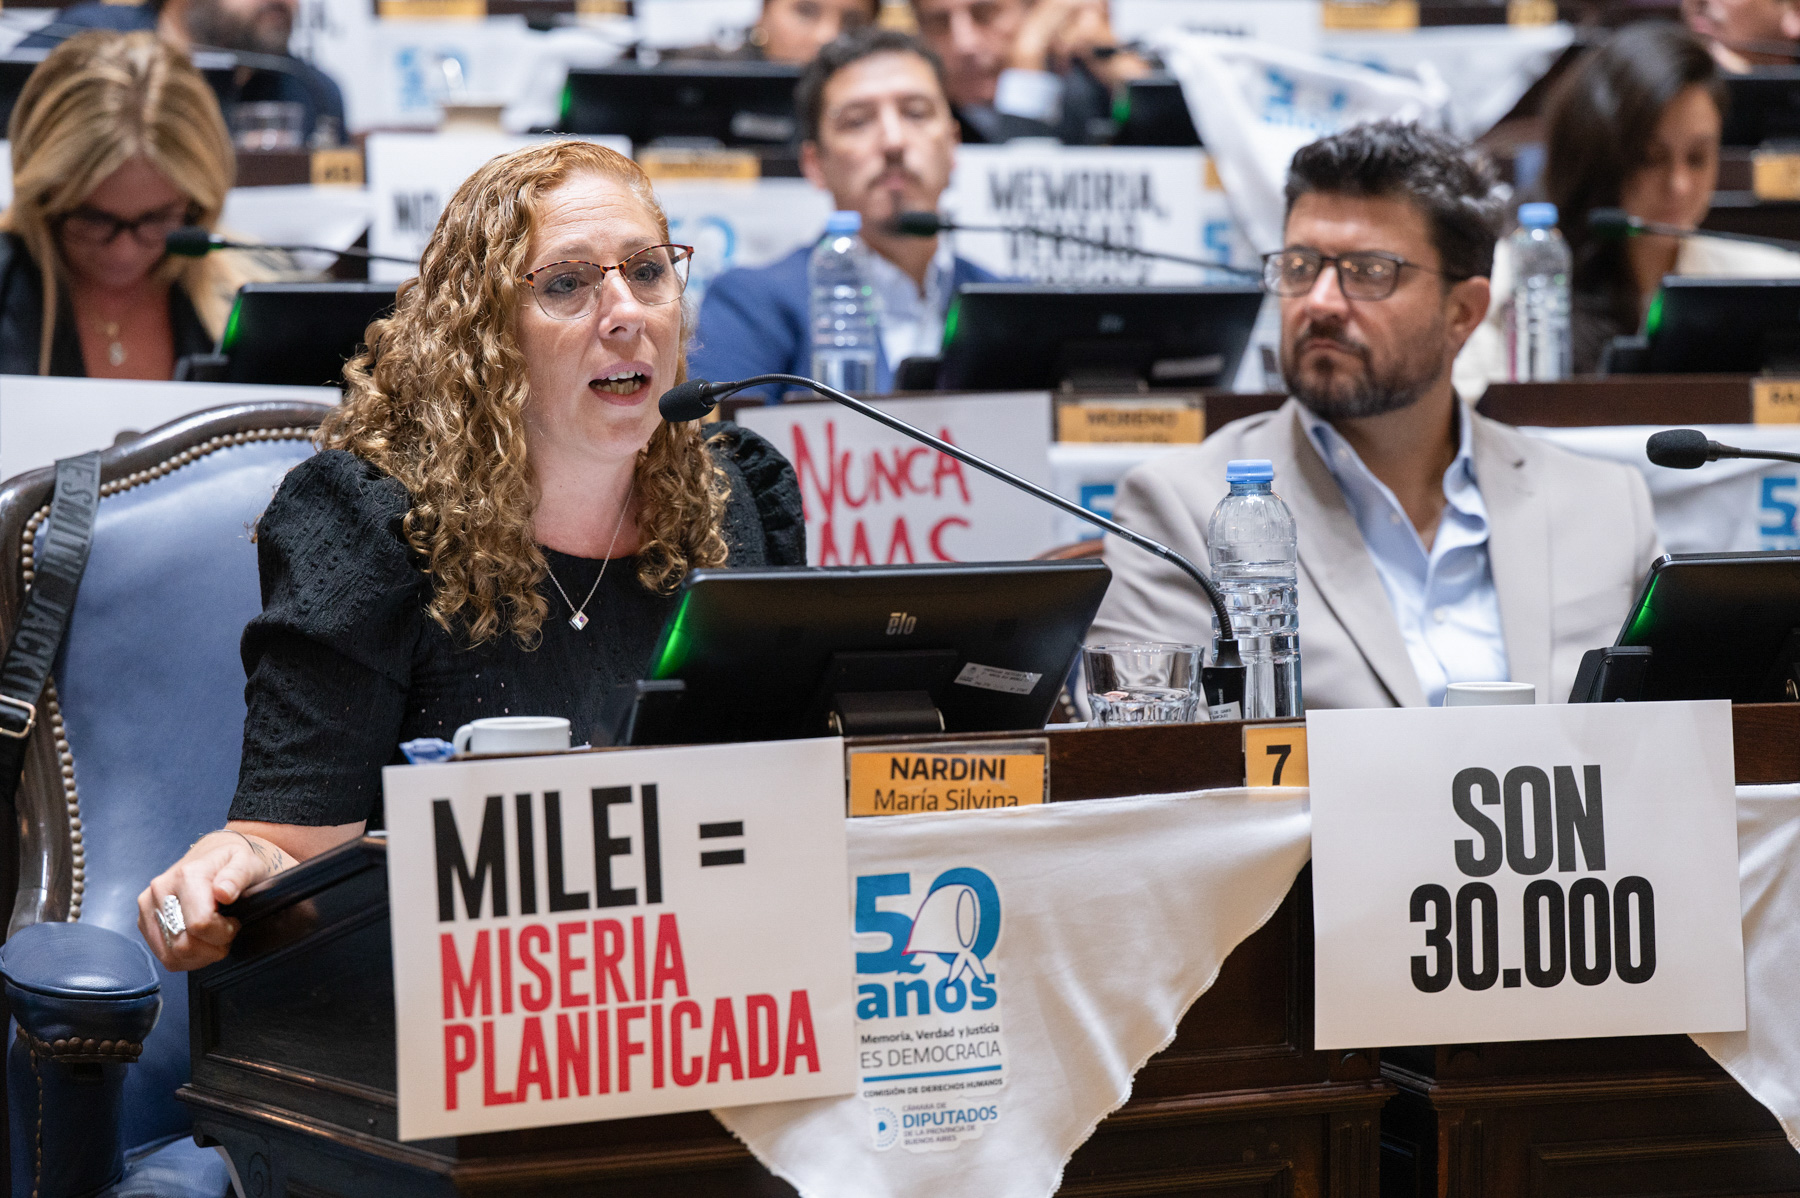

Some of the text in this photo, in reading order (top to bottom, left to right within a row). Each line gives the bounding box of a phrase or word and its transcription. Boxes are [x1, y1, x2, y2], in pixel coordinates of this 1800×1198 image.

[791, 420, 972, 522] NUNCA
[890, 757, 1006, 781] NARDINI
[1266, 744, 1291, 786] 7
[874, 786, 1019, 811] María Silvina
[1452, 764, 1606, 877] SON
[432, 783, 663, 923] MILEI
[855, 867, 1001, 975] 50
[1409, 875, 1657, 993] 30.000
[439, 912, 689, 1021] MISERIA
[444, 989, 821, 1111] PLANIFICADA
[860, 1022, 1000, 1045] Memoria, Verdad y Justicia
[860, 1040, 1002, 1069] ES DEMOCRACIA
[907, 1085, 918, 1095] DE
[920, 1082, 965, 1093] DERECHOS
[966, 1077, 1004, 1089] HUMANOS
[902, 1105, 998, 1128] DIPUTADOS
[926, 1125, 965, 1136] PROVINCIA
